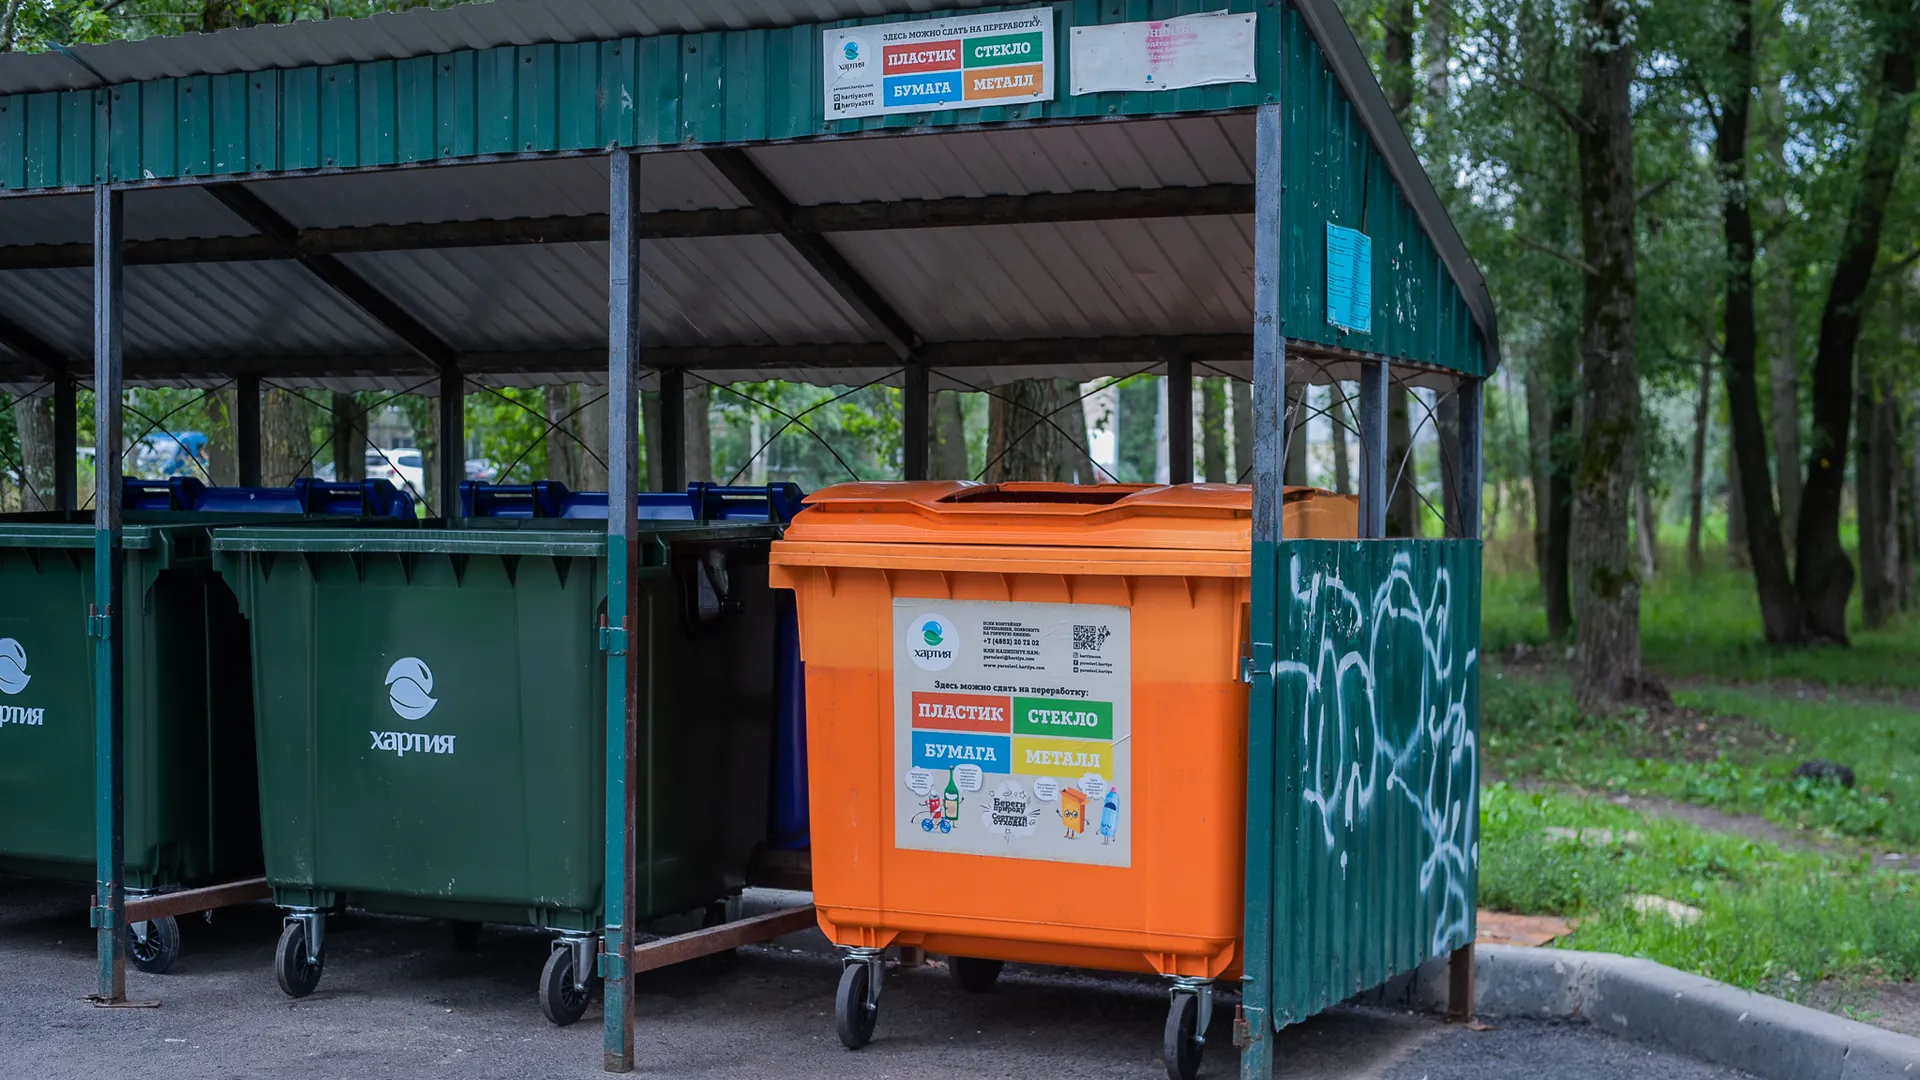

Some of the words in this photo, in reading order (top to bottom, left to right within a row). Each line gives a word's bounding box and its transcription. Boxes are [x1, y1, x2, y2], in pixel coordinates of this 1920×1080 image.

[883, 33, 908, 41] ЗДЕСЬ
[908, 29, 941, 39] МОЖНО
[942, 26, 968, 36] СДАТЬ
[969, 25, 982, 33] НА
[983, 19, 1043, 32] ПЕРЕРАБОТКУ:
[888, 48, 956, 67] ПЛАСТИК
[974, 41, 1031, 59] СТЕКЛО
[893, 81, 952, 98] БУМАГА
[973, 74, 1034, 92] МЕТАЛЛ
[914, 649, 952, 660] хартия
[934, 680, 959, 690] Здесь
[959, 683, 992, 691] можно
[992, 685, 1018, 693] сдать
[1031, 687, 1090, 698] переработку:
[918, 703, 1004, 722] ПЛАСТИК
[1027, 709, 1099, 727] СТЕКЛО
[370, 731, 456, 757] хартия
[924, 743, 997, 761] БУМАГА
[1025, 749, 1101, 768] МЕТАЛЛ
[993, 797, 1026, 808] Береги
